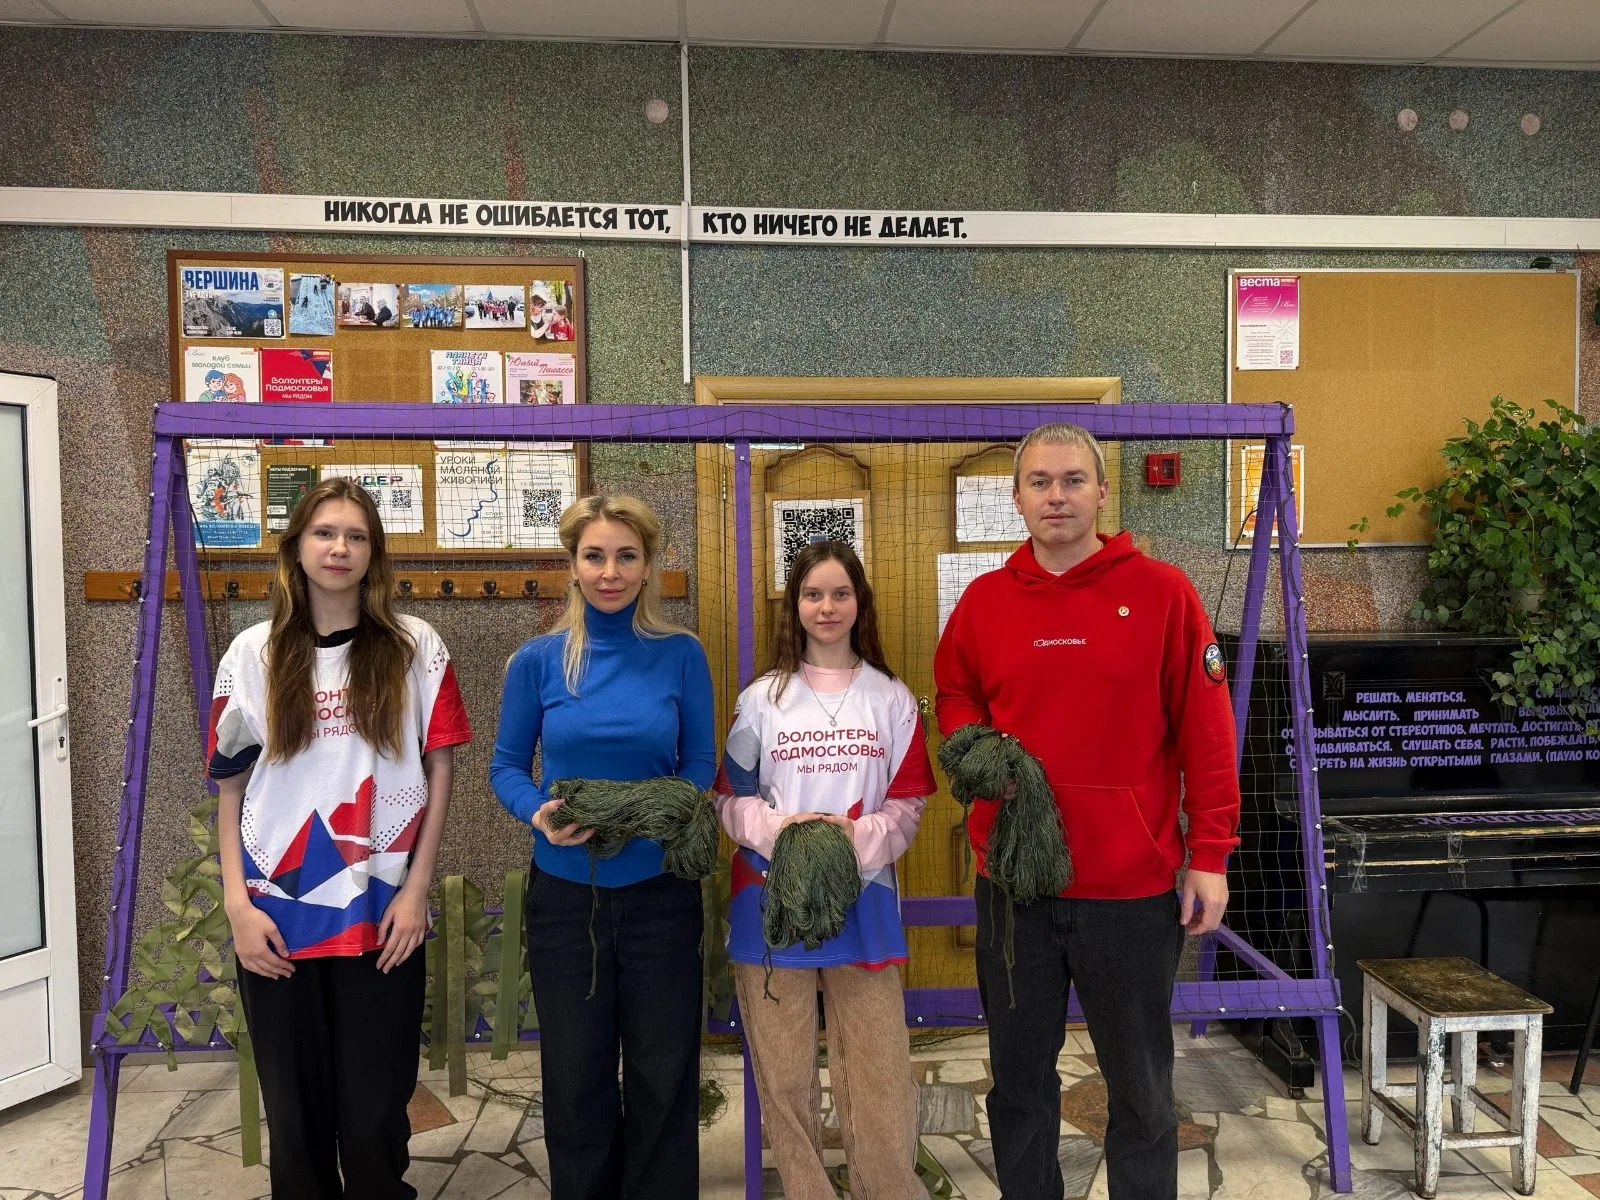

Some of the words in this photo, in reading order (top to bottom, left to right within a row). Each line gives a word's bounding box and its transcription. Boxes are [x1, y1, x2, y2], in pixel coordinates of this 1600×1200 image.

[324, 200, 433, 225] НИКОГДА
[440, 203, 469, 225] НЕ
[475, 204, 617, 230] ОШИБАЕТСЯ
[625, 207, 671, 234] ТОТ,
[703, 212, 747, 234] КТО
[753, 213, 838, 237] НИЧЕГО
[844, 215, 872, 237] НЕ
[878, 216, 967, 239] ДЕЛАЕТ.
[184, 270, 259, 291] ВЕРШИНА
[445, 352, 488, 360] ПЛАНЕТА
[508, 356, 540, 367] Юный
[440, 455, 476, 465] УРОКИ
[440, 465, 501, 475] МАСЛЯНОЙ
[440, 475, 503, 485] ЖИВОПИСИ
[1356, 692, 1402, 704] РЕШАТЬ.
[1406, 691, 1466, 704] МЕНЯТЬСЯ.
[1343, 709, 1400, 722] МЫСЛИТЬ.
[1414, 708, 1480, 721] ПРИНИМАТЬ
[323, 723, 357, 738] РЯДО
[1281, 726, 1369, 740] ОТЗЫВАТЬСЯ
[1371, 726, 1386, 738] ОТ
[1389, 723, 1467, 737] СТЕРЕОТИПОВ.
[1469, 722, 1519, 735] МЕЧТАТЬ.
[1521, 719, 1584, 733] ДОСТИГАТЬ.
[777, 729, 879, 746] ВОЛОНТЕРЫ
[1402, 739, 1452, 751] СЛУШАТЬ
[1454, 738, 1484, 751] СЕБЯ.
[1490, 736, 1528, 749] РАСТИ.
[1530, 733, 1597, 748] ПОБЕЖДАТЬ.
[770, 744, 885, 763] ПОДМОСКОВЬЯ
[1289, 756, 1347, 769] СТРЕТЬ
[1347, 757, 1365, 769] НА
[1368, 756, 1407, 768] ЖИЗНЬ
[1410, 754, 1482, 767] ОТКРЫТЫМИ
[1490, 751, 1543, 764] ГЛАЗАМИ.
[1545, 749, 1583, 764] (ПАУЛО
[797, 764, 815, 774] МЫ
[818, 762, 858, 774] РЯДОМ
